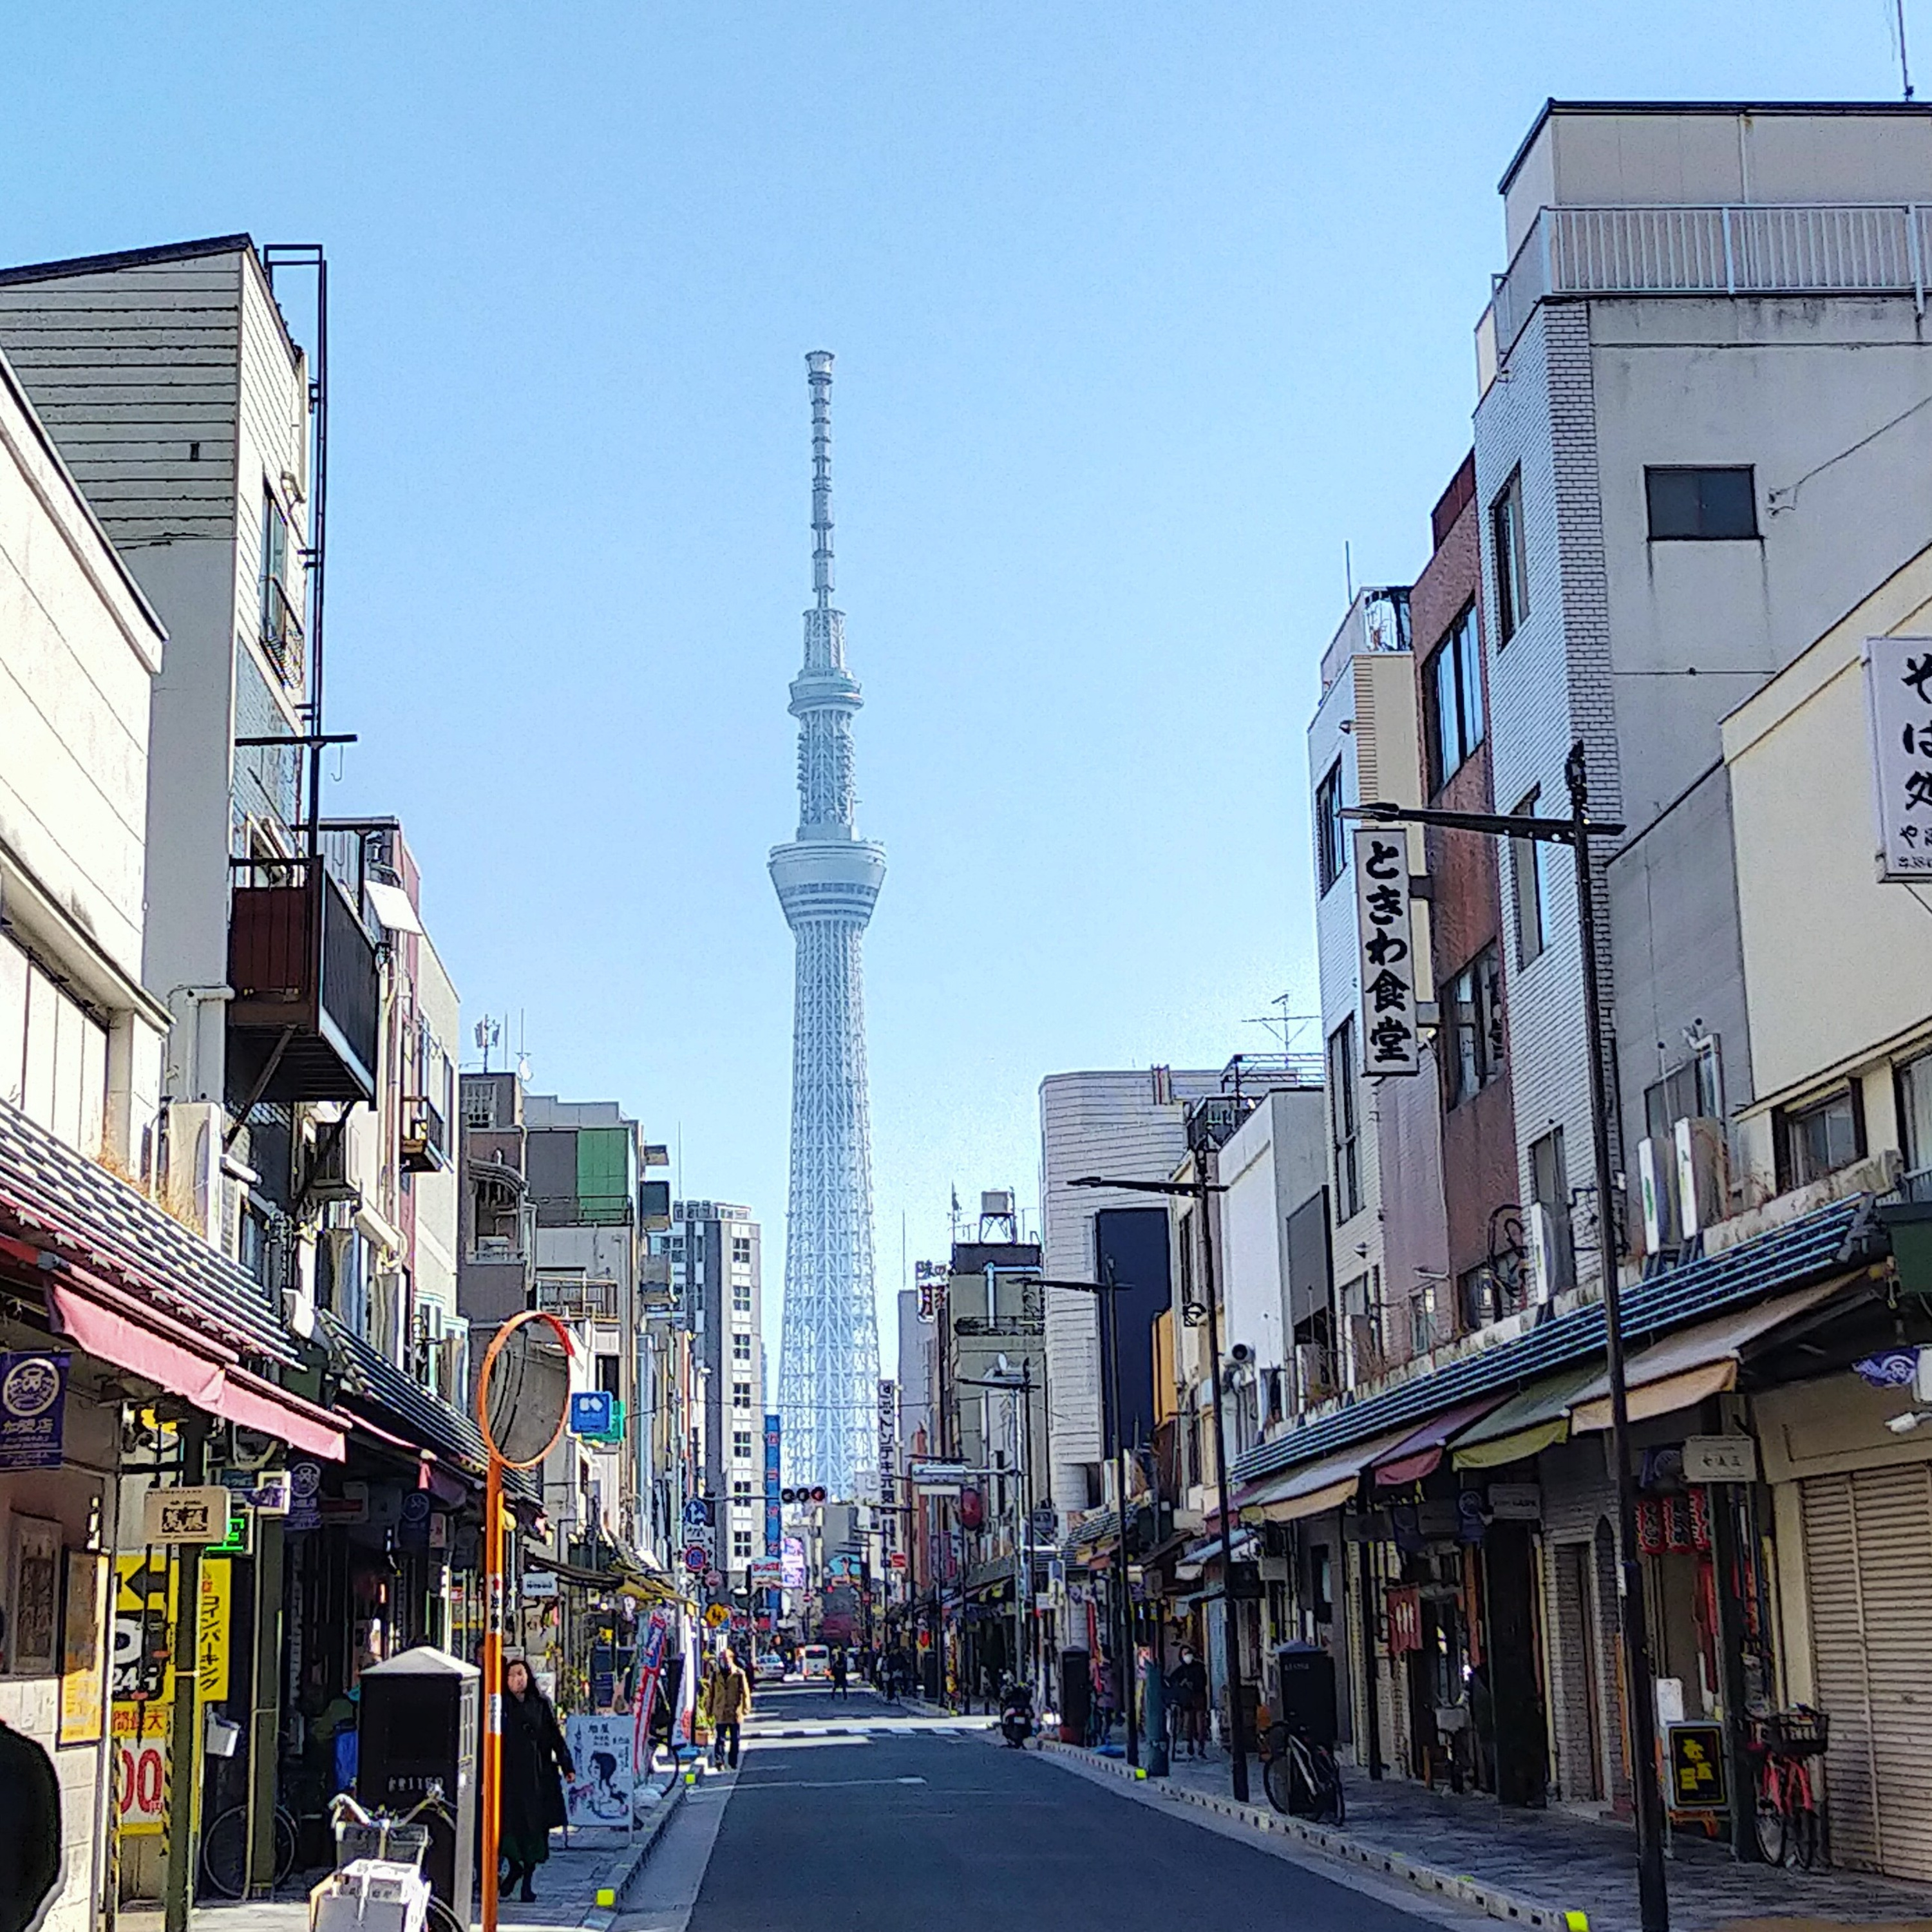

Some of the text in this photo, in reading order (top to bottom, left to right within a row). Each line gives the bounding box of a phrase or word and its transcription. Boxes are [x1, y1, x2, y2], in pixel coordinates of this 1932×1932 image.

[1365, 840, 1412, 1063] ときわ食堂
